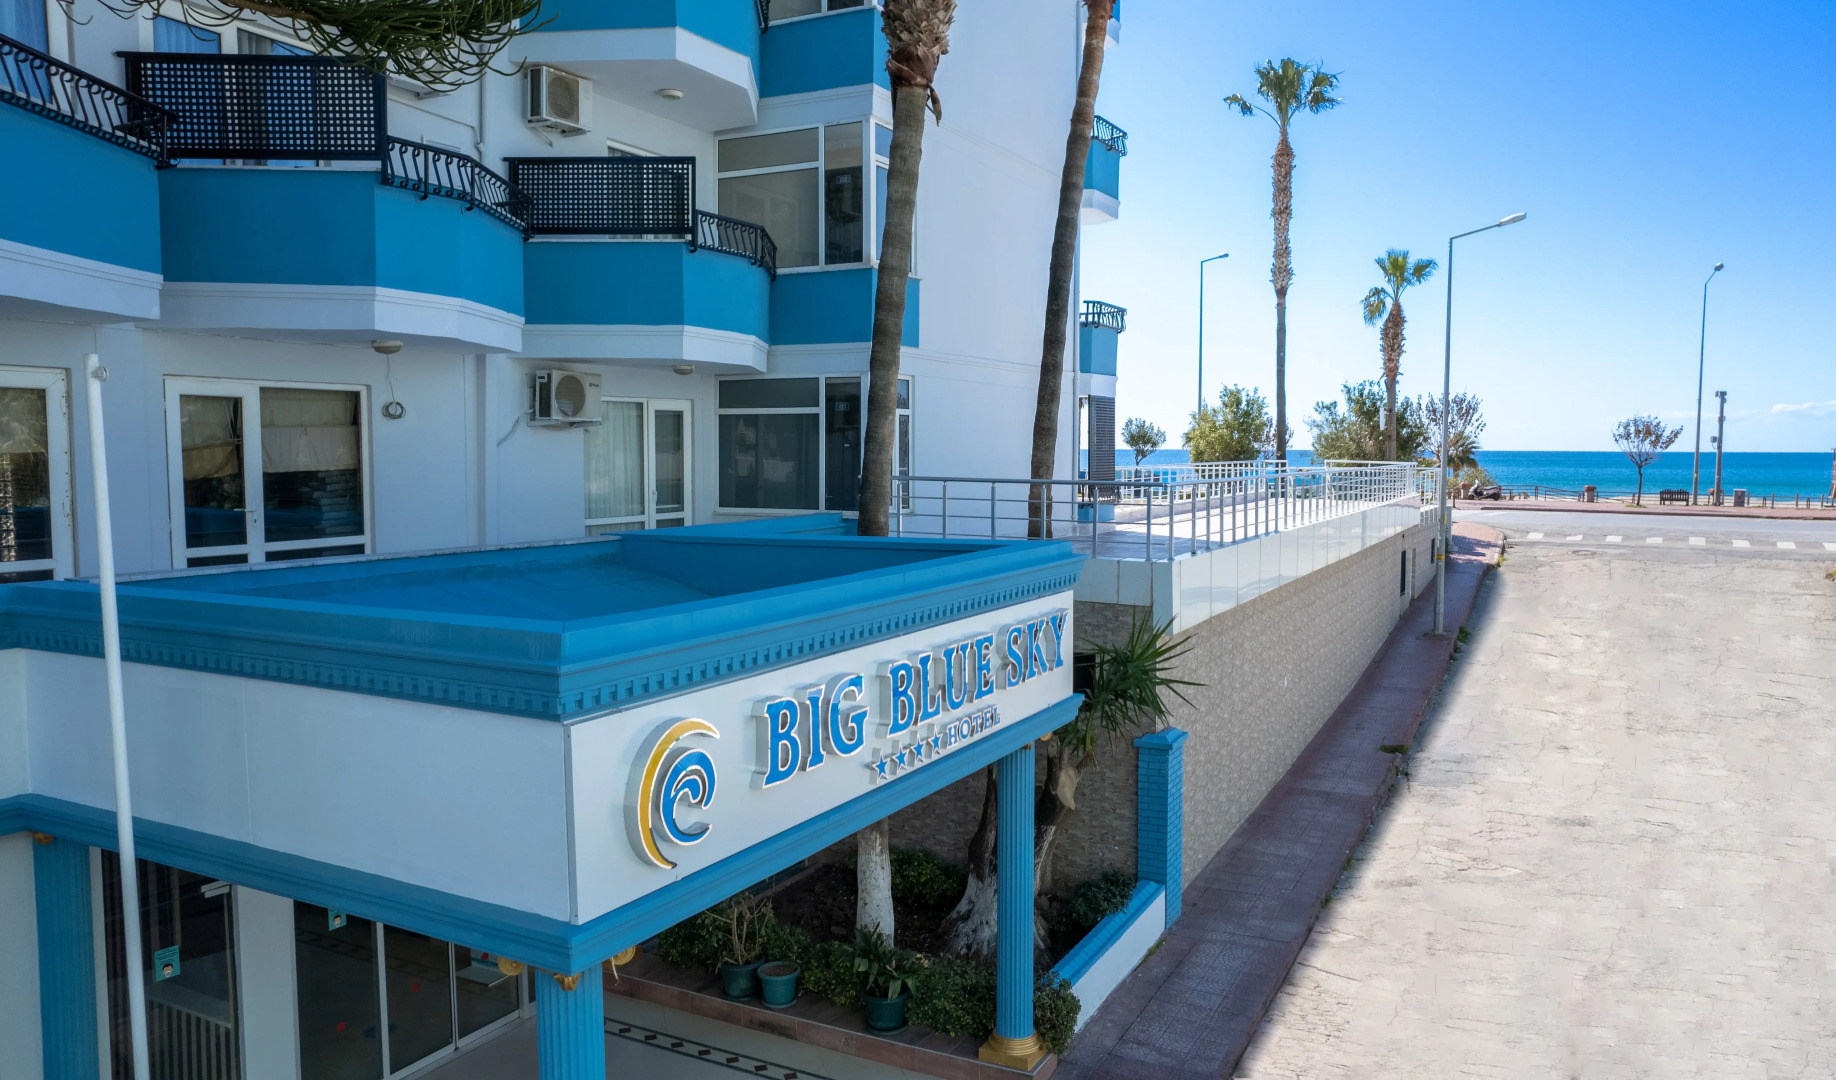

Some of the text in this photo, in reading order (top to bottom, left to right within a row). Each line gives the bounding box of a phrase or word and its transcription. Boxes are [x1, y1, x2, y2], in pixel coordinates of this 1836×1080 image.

[762, 610, 1069, 788] BIG BLUE SKY
[946, 704, 1000, 748] HOTEL
